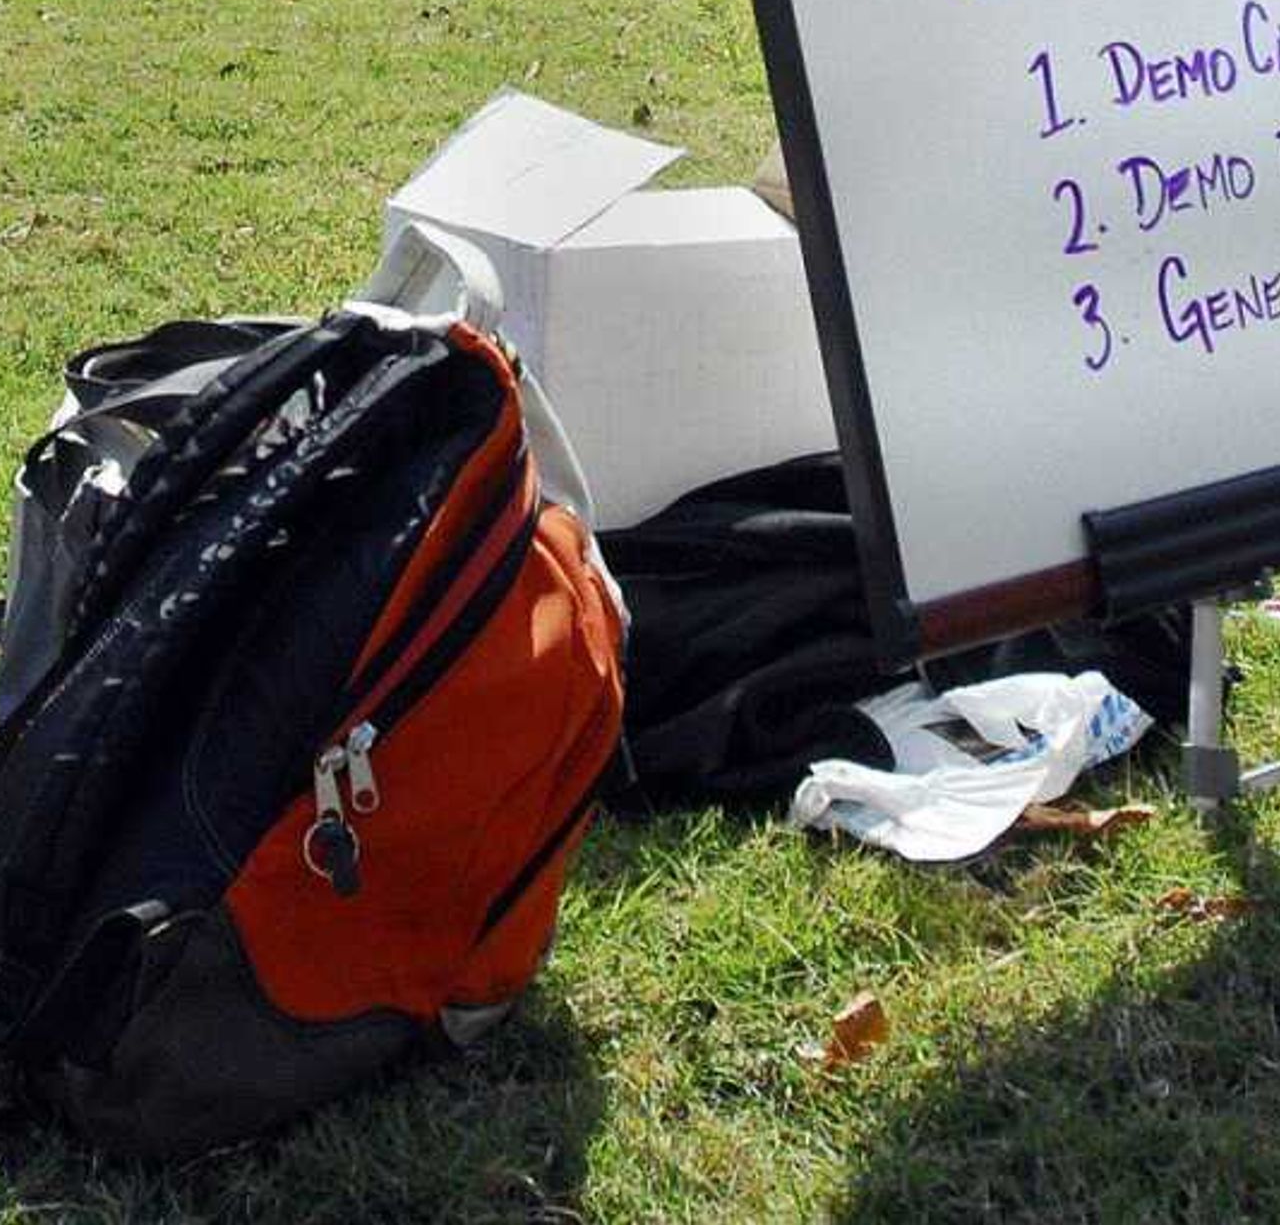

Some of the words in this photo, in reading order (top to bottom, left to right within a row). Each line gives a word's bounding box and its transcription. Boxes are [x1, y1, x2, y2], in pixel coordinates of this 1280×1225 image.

[1027, 49, 1089, 140] 1.
[1097, 39, 1239, 108] DEMO
[1051, 177, 1110, 257] 2.
[1070, 282, 1131, 373] 3.
